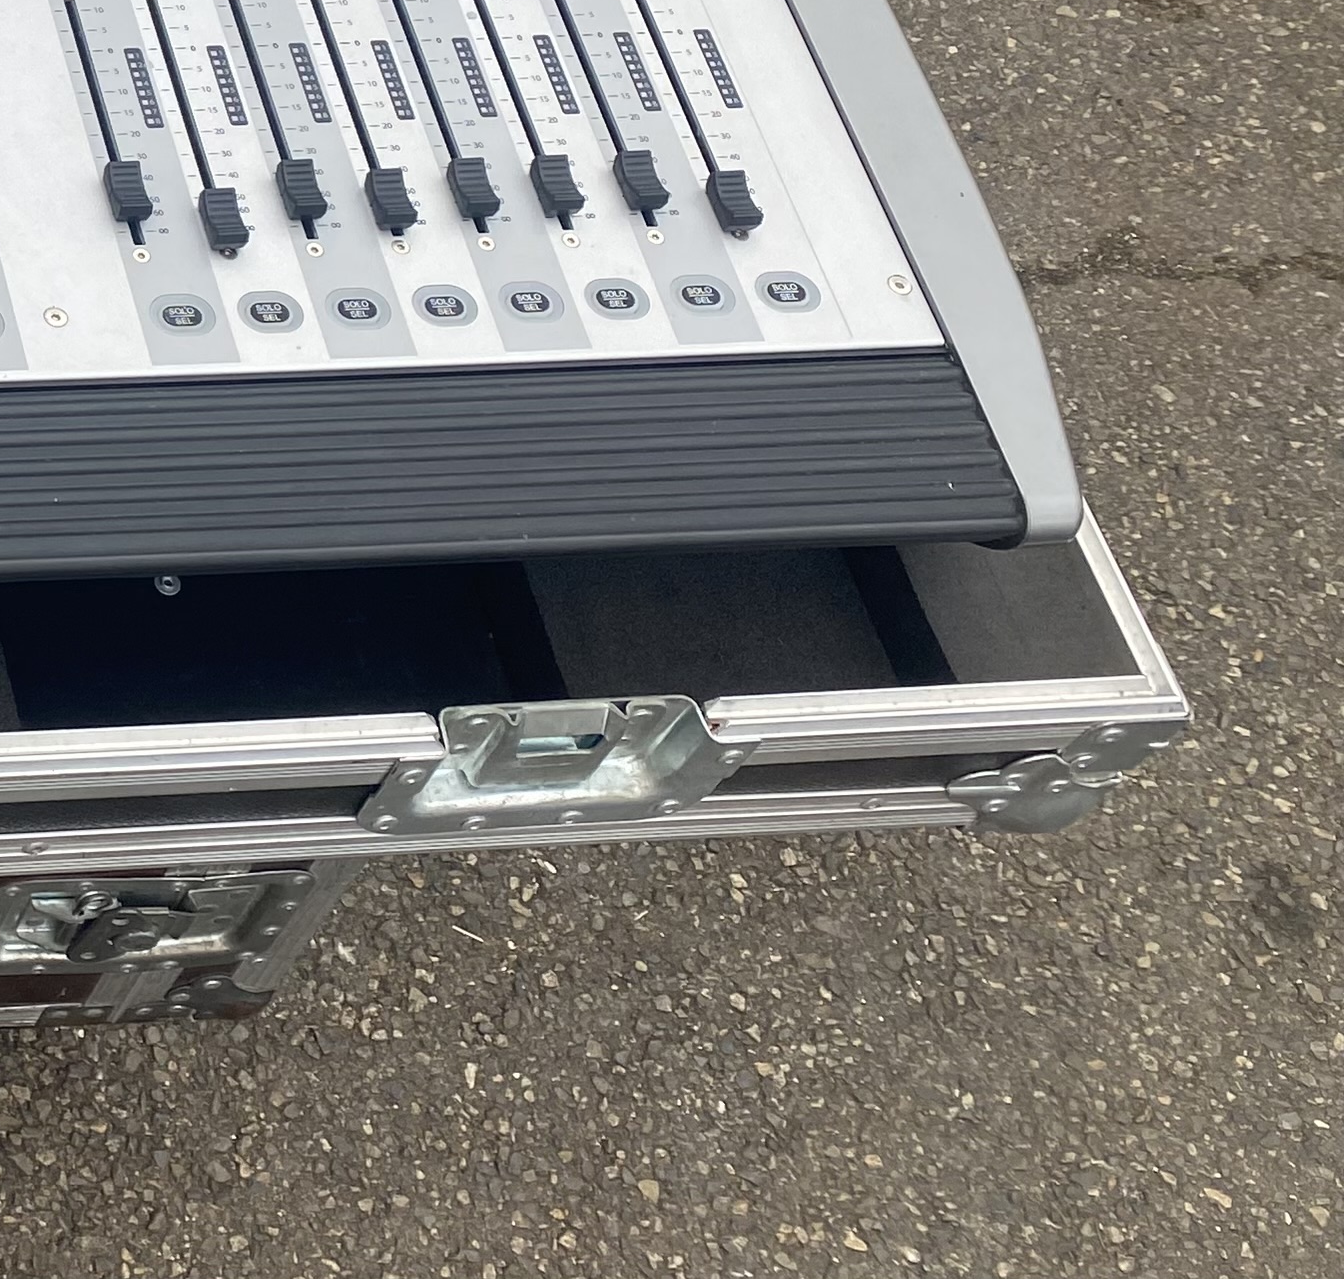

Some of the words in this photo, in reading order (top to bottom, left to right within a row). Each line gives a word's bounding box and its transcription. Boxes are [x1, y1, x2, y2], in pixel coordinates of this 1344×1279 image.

[772, 283, 798, 291] SOLO
[601, 289, 627, 298] SOLO
[780, 292, 798, 300] SEL
[430, 298, 456, 306] SOLO
[168, 306, 195, 315] SOLO
[255, 303, 282, 311] SOLO
[437, 307, 456, 315] SEL
[175, 317, 193, 325] SEL
[263, 313, 281, 321] SEL
